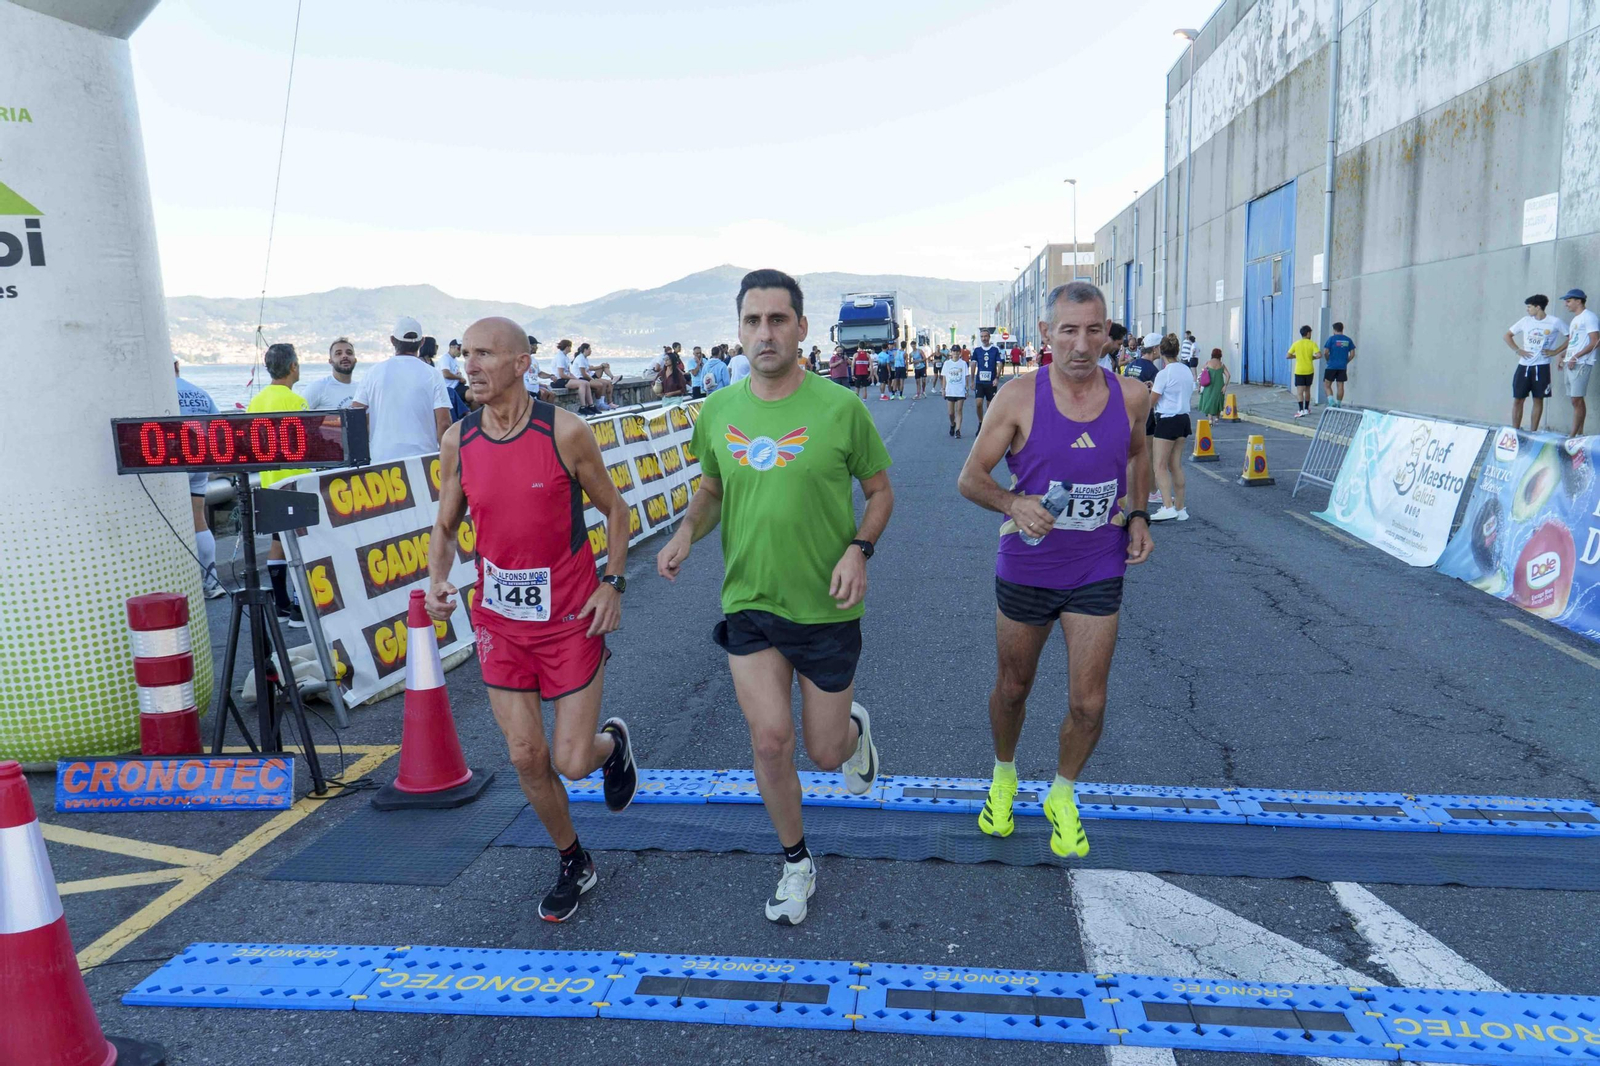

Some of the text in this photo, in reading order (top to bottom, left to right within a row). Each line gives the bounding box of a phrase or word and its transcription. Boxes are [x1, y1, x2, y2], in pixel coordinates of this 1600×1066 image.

[179, 399, 209, 408] ELESTE
[140, 416, 306, 465] 0:00:00
[1500, 433, 1517, 447] Dole
[1426, 439, 1454, 463] Chef
[1417, 462, 1464, 493] Maestro
[328, 467, 407, 516] GADIS
[1075, 486, 1102, 495] ALFONSO
[1412, 486, 1436, 507] Galicia
[1066, 498, 1109, 518] 133
[499, 572, 528, 580] ALFONSO
[1531, 558, 1556, 577] Dole
[494, 583, 542, 606] 148
[63, 757, 286, 793] CRONOTEC
[1101, 786, 1184, 794] CRONOTEC
[64, 795, 284, 809] WWW.CRONOTEC.ES
[232, 948, 338, 958] CRONOTEC
[683, 960, 795, 973] CRONOTEC
[380, 972, 596, 993] CRONOTEC
[923, 971, 1040, 985] CRONOTEC
[1173, 983, 1294, 998] CRONOTEC
